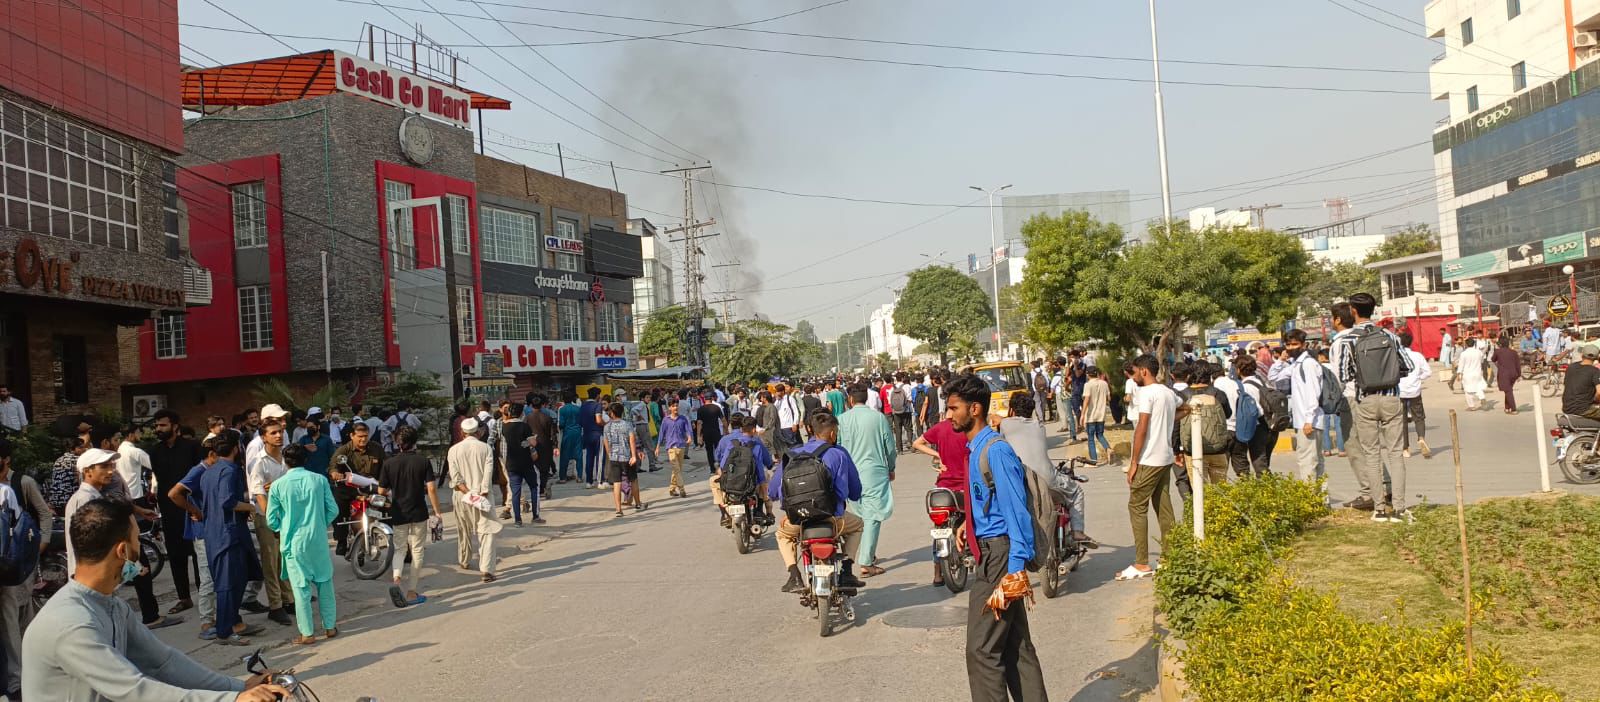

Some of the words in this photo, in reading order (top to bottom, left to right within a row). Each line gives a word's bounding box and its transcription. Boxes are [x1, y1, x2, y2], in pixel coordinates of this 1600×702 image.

[341, 57, 394, 99] Cash
[399, 76, 424, 108] Co
[428, 86, 469, 123] Mart
[1476, 106, 1512, 128] oppo
[546, 237, 560, 248] CPL
[561, 239, 583, 251] LEADS
[81, 276, 129, 300] PIZZA
[131, 283, 186, 307] VALLEY
[518, 345, 537, 367] Co
[542, 345, 575, 366] Mart
